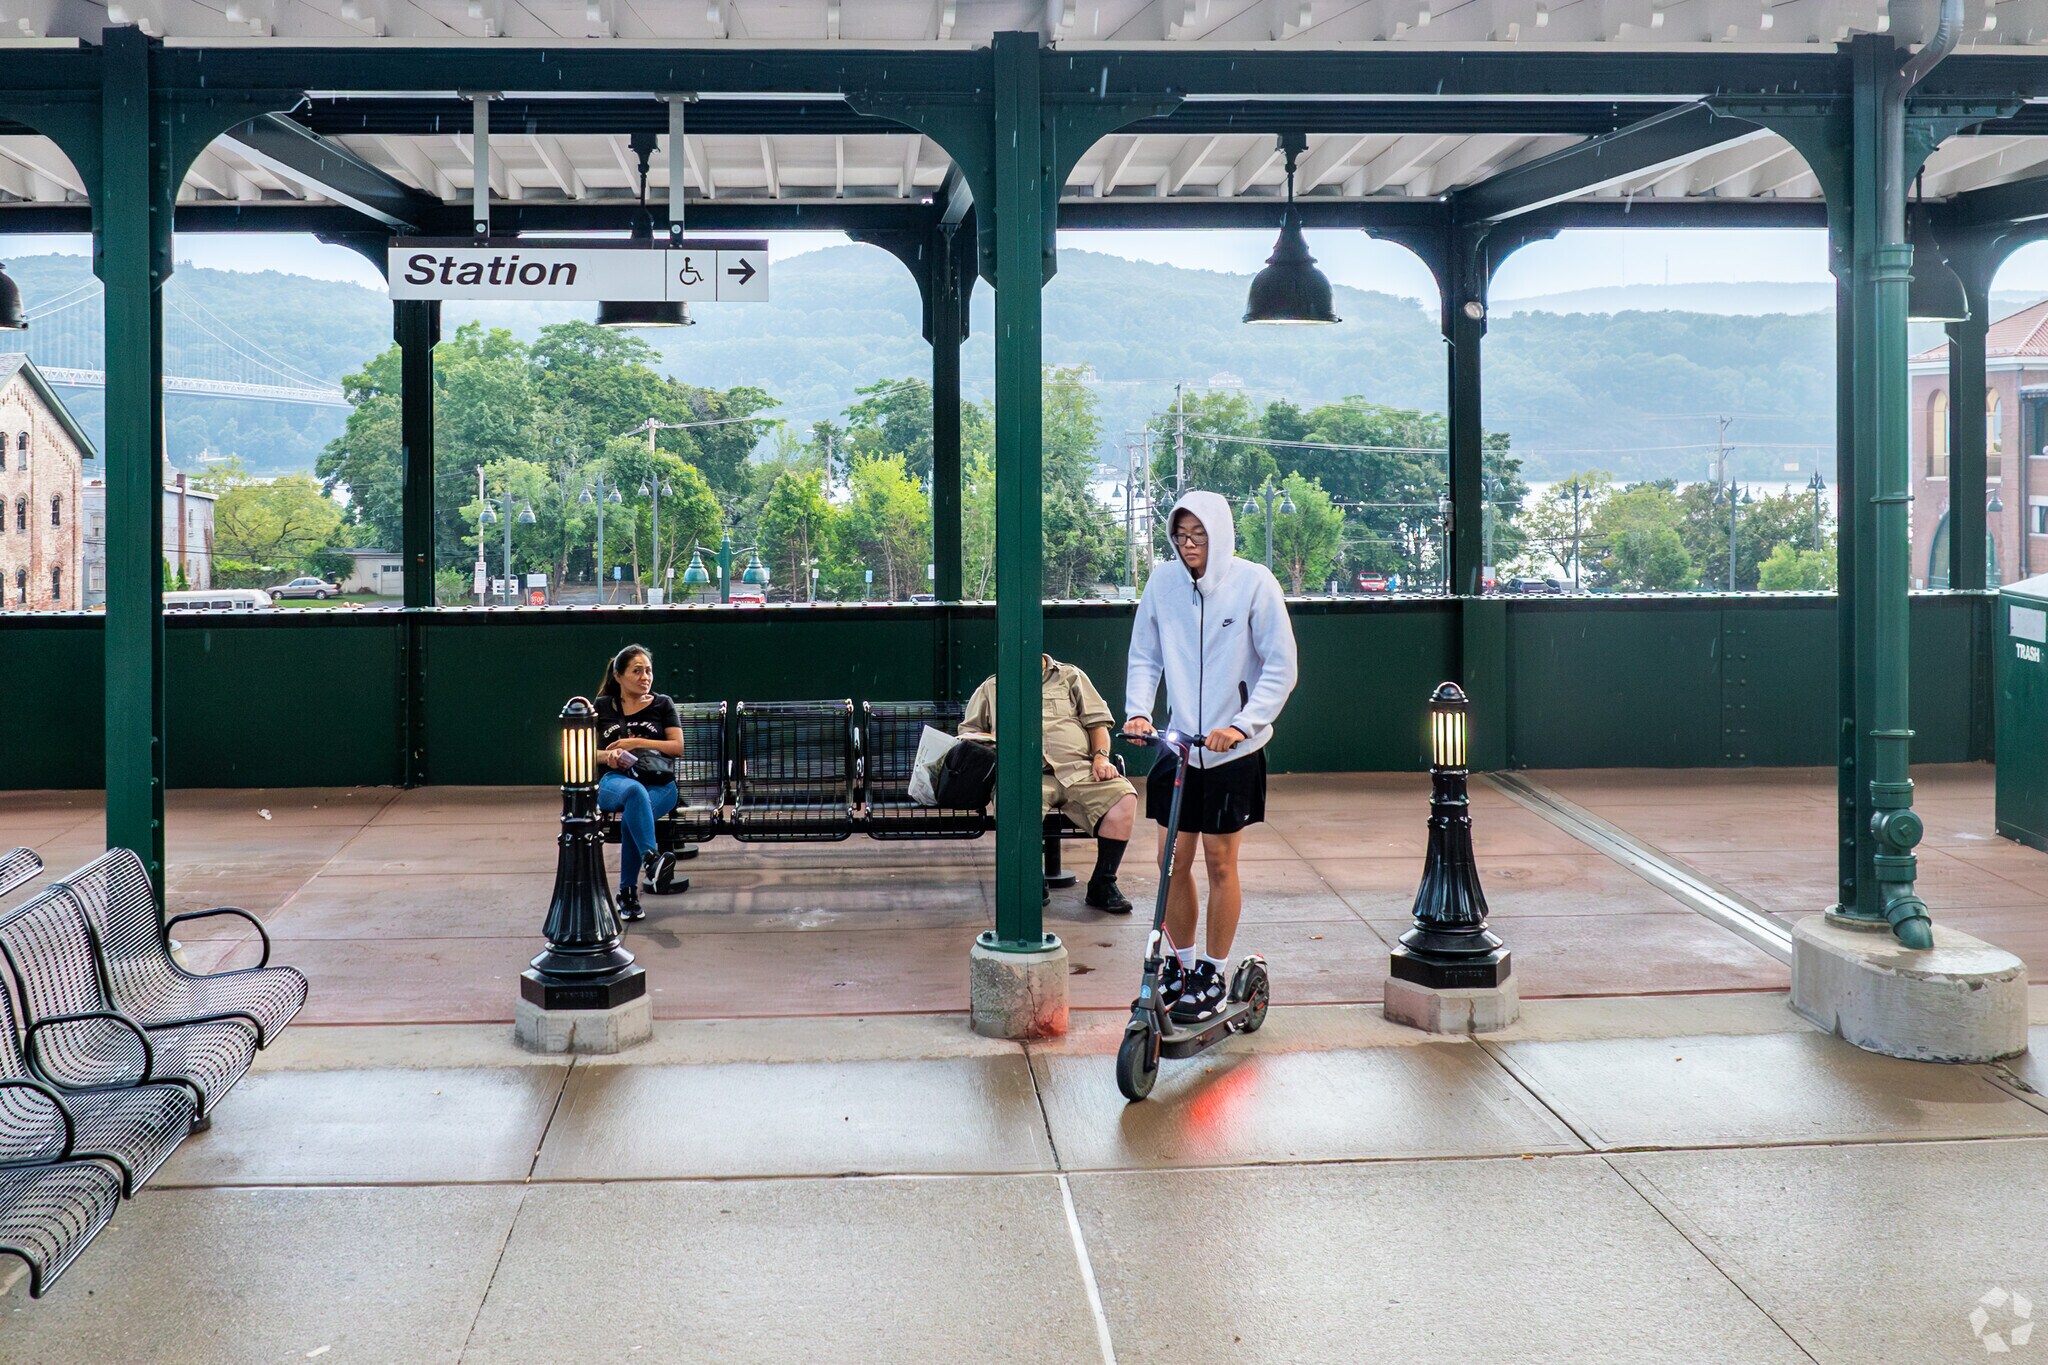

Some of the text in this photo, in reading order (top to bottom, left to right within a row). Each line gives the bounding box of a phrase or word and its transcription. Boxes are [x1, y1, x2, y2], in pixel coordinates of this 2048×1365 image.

[404, 253, 577, 286] Station
[530, 596, 545, 605] STOP
[2015, 643, 2040, 663] TRASH
[603, 724, 621, 738] Com
